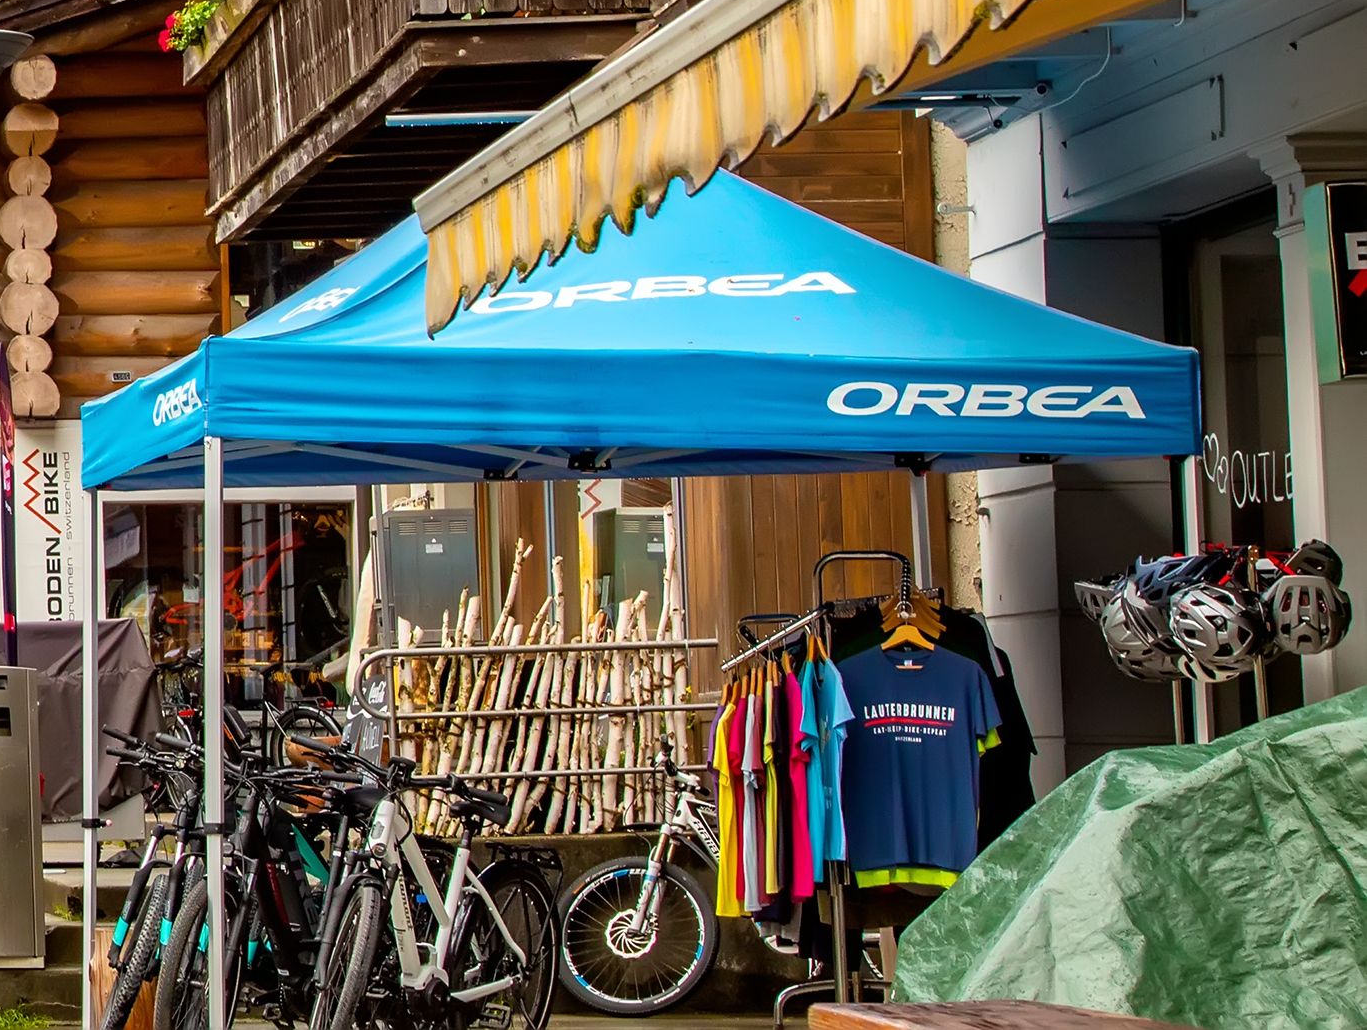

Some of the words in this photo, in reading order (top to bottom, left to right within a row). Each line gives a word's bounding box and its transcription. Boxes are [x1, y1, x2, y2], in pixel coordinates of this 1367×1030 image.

[470, 271, 857, 315] ORBEA
[152, 378, 203, 426] ORBEA
[827, 381, 1146, 419] ORBEA
[43, 452, 59, 515] BIKE
[62, 451, 73, 540] switzerland
[863, 703, 955, 721] LAUTERBRUNNEN
